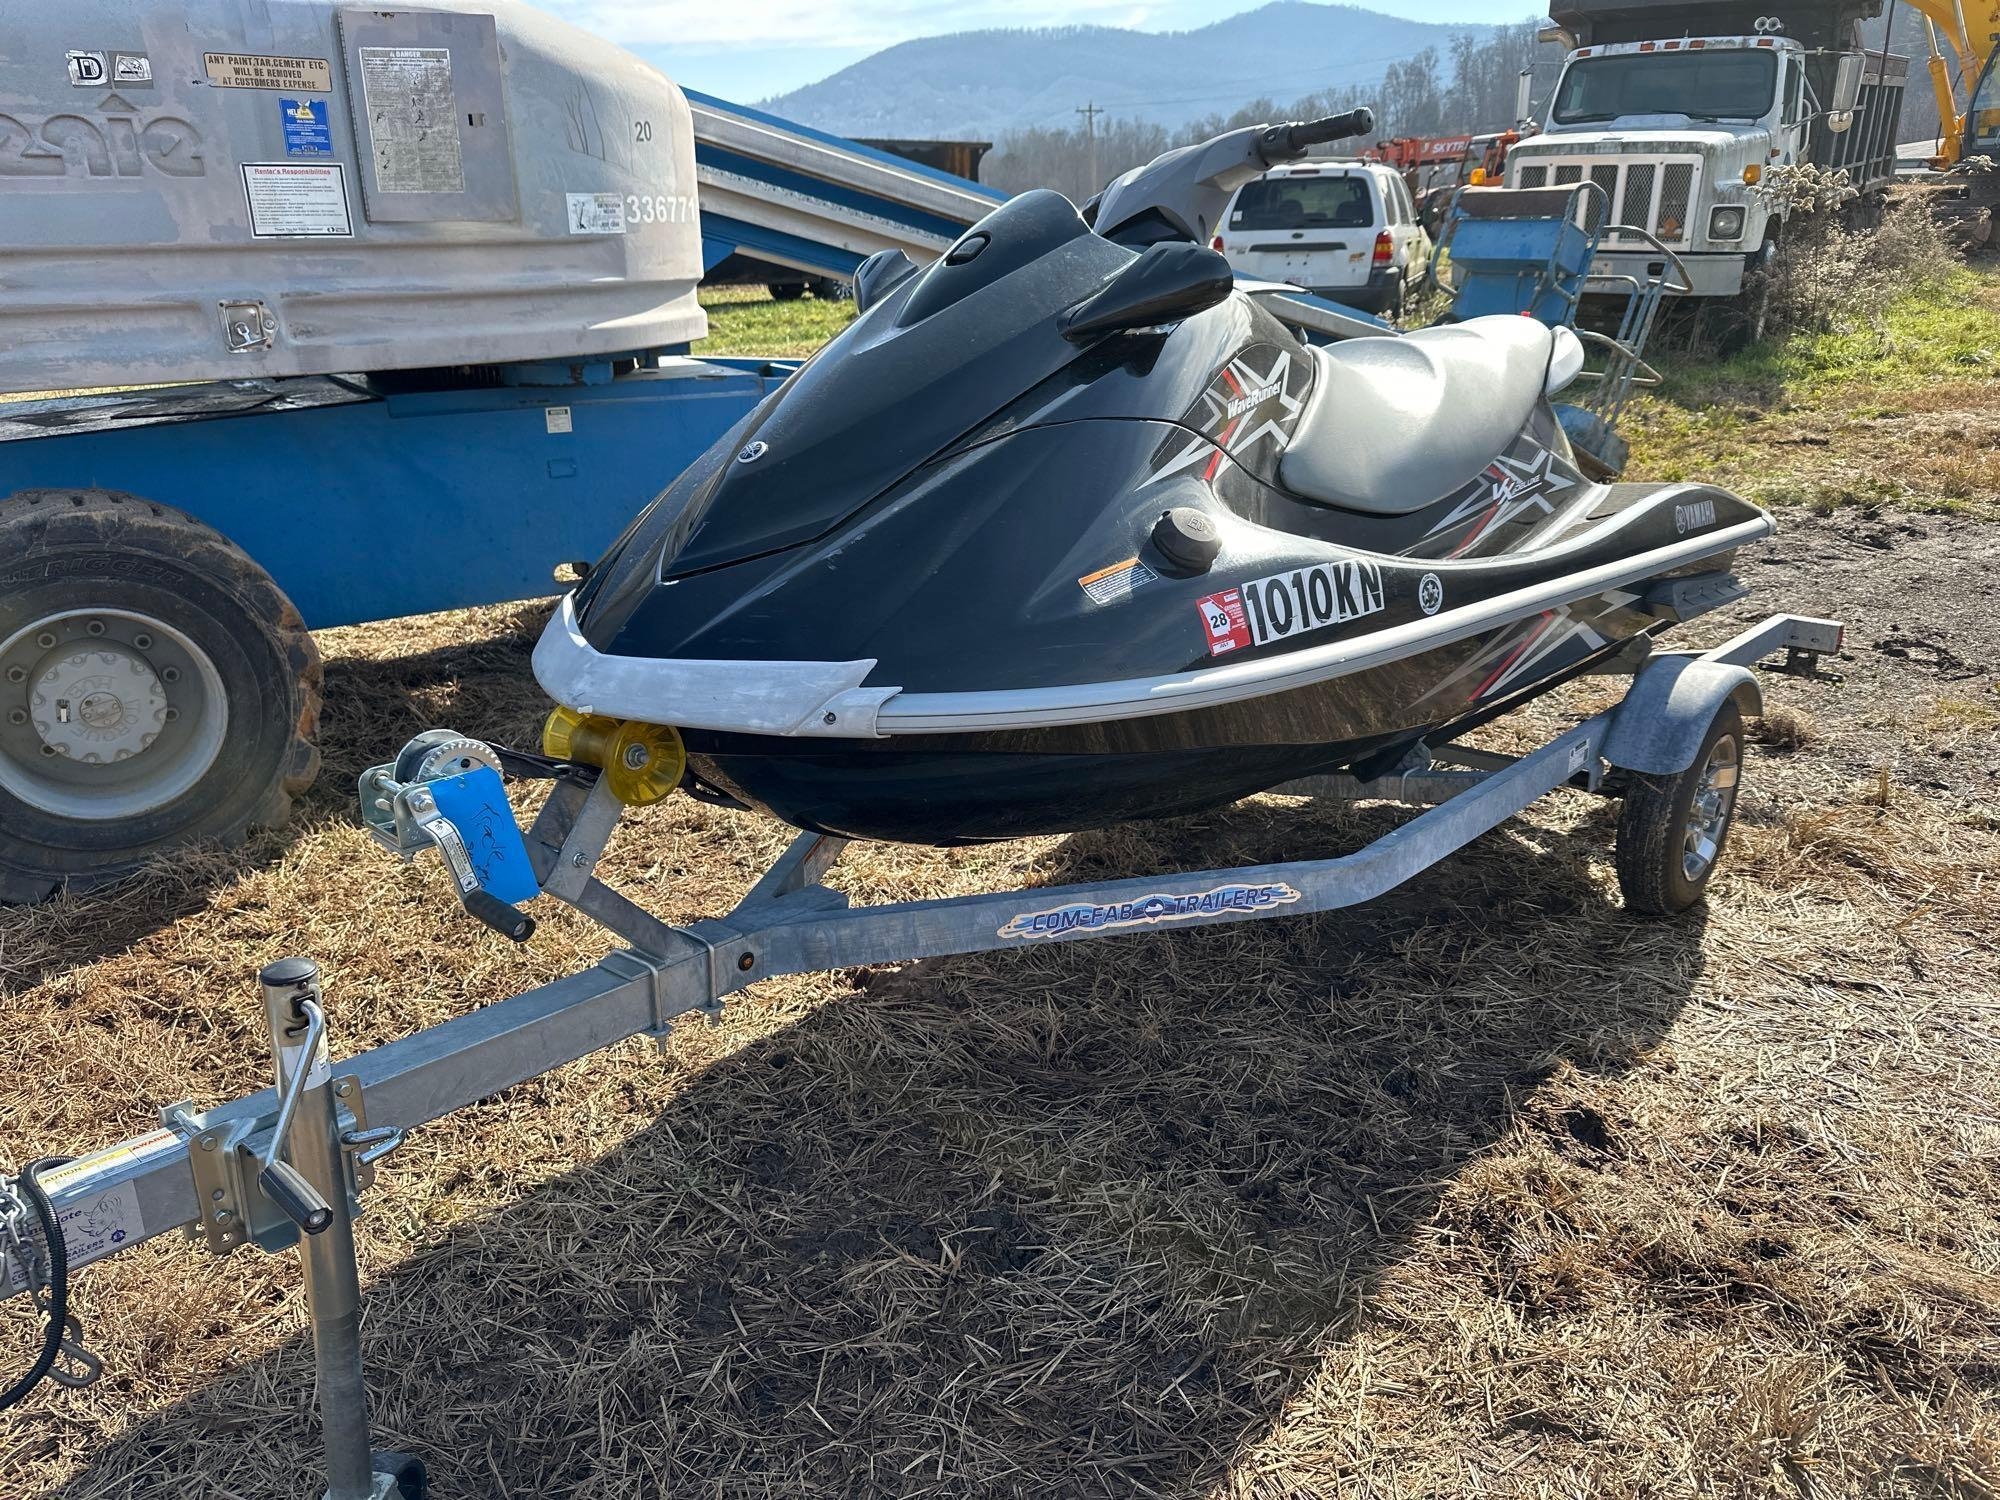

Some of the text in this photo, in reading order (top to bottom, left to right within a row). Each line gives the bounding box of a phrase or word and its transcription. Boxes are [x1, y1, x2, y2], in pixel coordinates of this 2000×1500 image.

[208, 55, 225, 64] ANY
[308, 61, 326, 70] ETC.
[233, 67, 302, 79] WILL BE REMOVED
[222, 77, 319, 90] AT CUSTOMERS EXPENSE.
[0, 93, 206, 176] enie
[635, 121, 652, 142] 20
[282, 168, 331, 176] Responsibilities
[626, 195, 697, 223] 336771
[1227, 381, 1281, 420] WaveRunner
[1683, 499, 1717, 531] YAMAHA
[1246, 561, 1382, 642] 1010KN
[1211, 613, 1228, 629] 28
[1032, 886, 1273, 931] COM-FAB TRAILERS
[43, 1166, 83, 1183] AUTION
[67, 1239, 104, 1258] RAILERS
